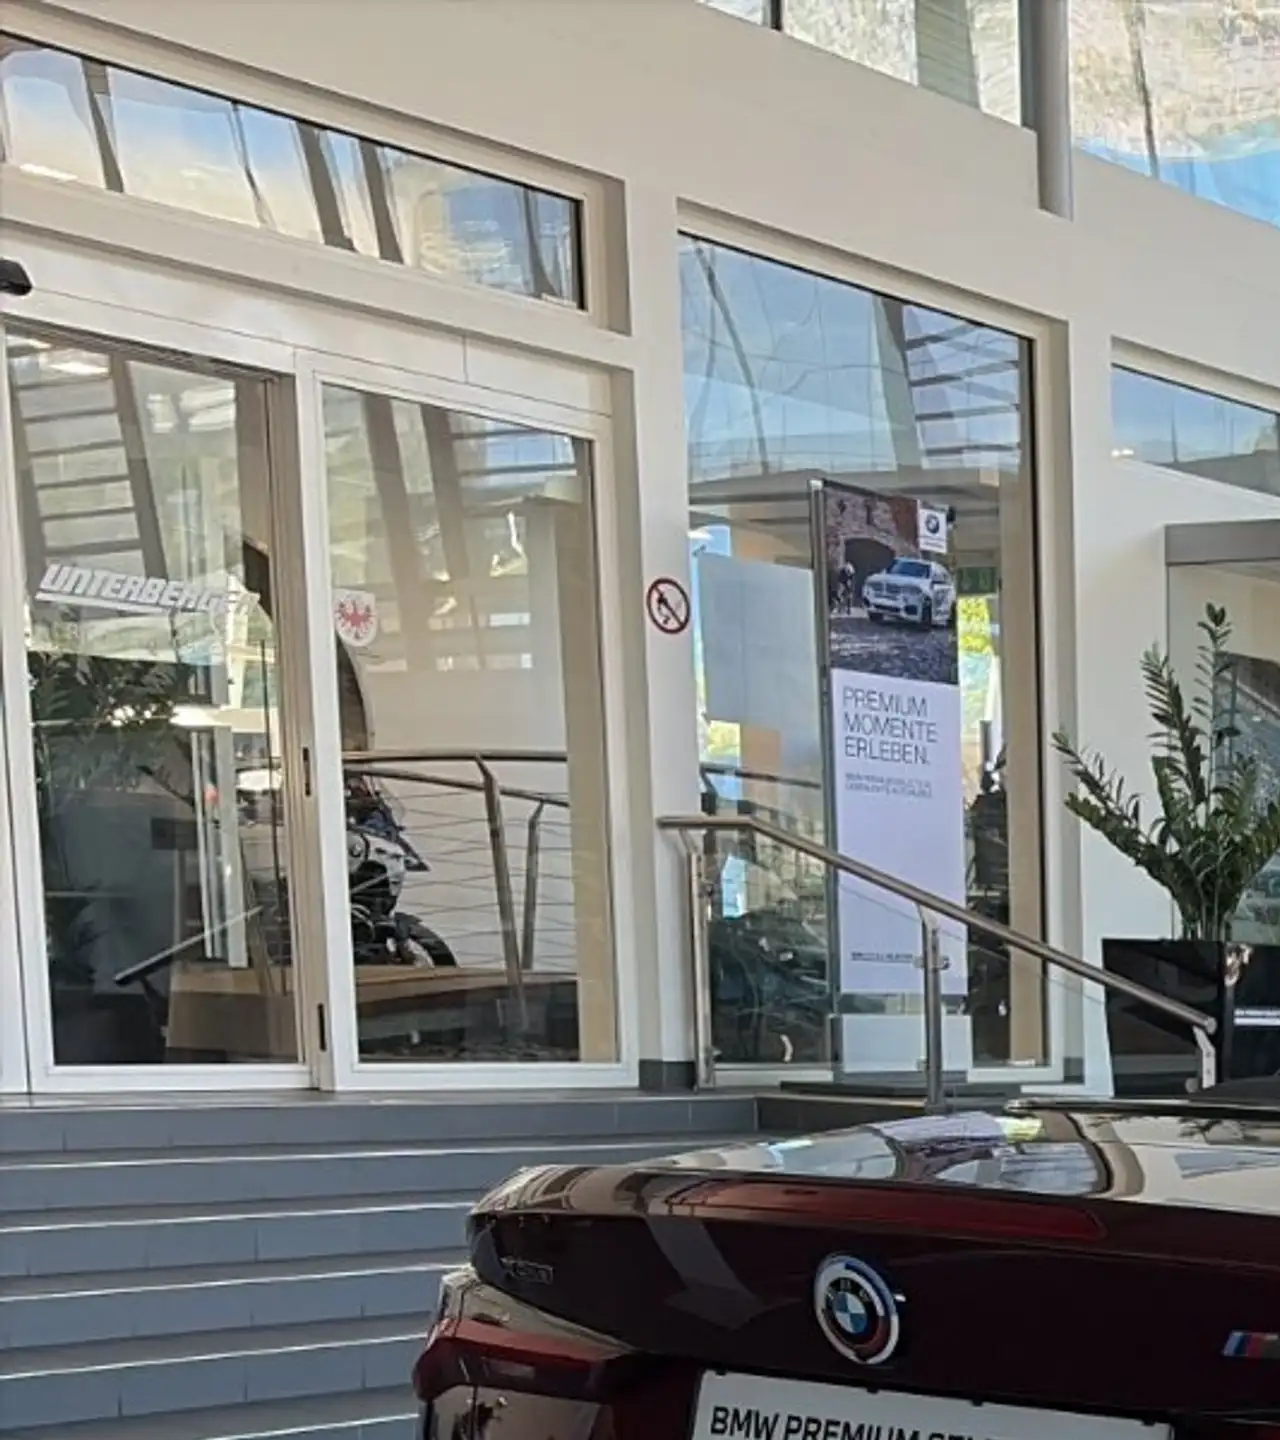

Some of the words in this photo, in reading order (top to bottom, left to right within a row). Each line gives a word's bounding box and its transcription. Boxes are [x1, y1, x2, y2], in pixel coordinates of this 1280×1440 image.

[842, 684, 929, 718] PREMIUM
[843, 711, 939, 745] MOMENTE
[844, 735, 932, 766] ERLEBEN.
